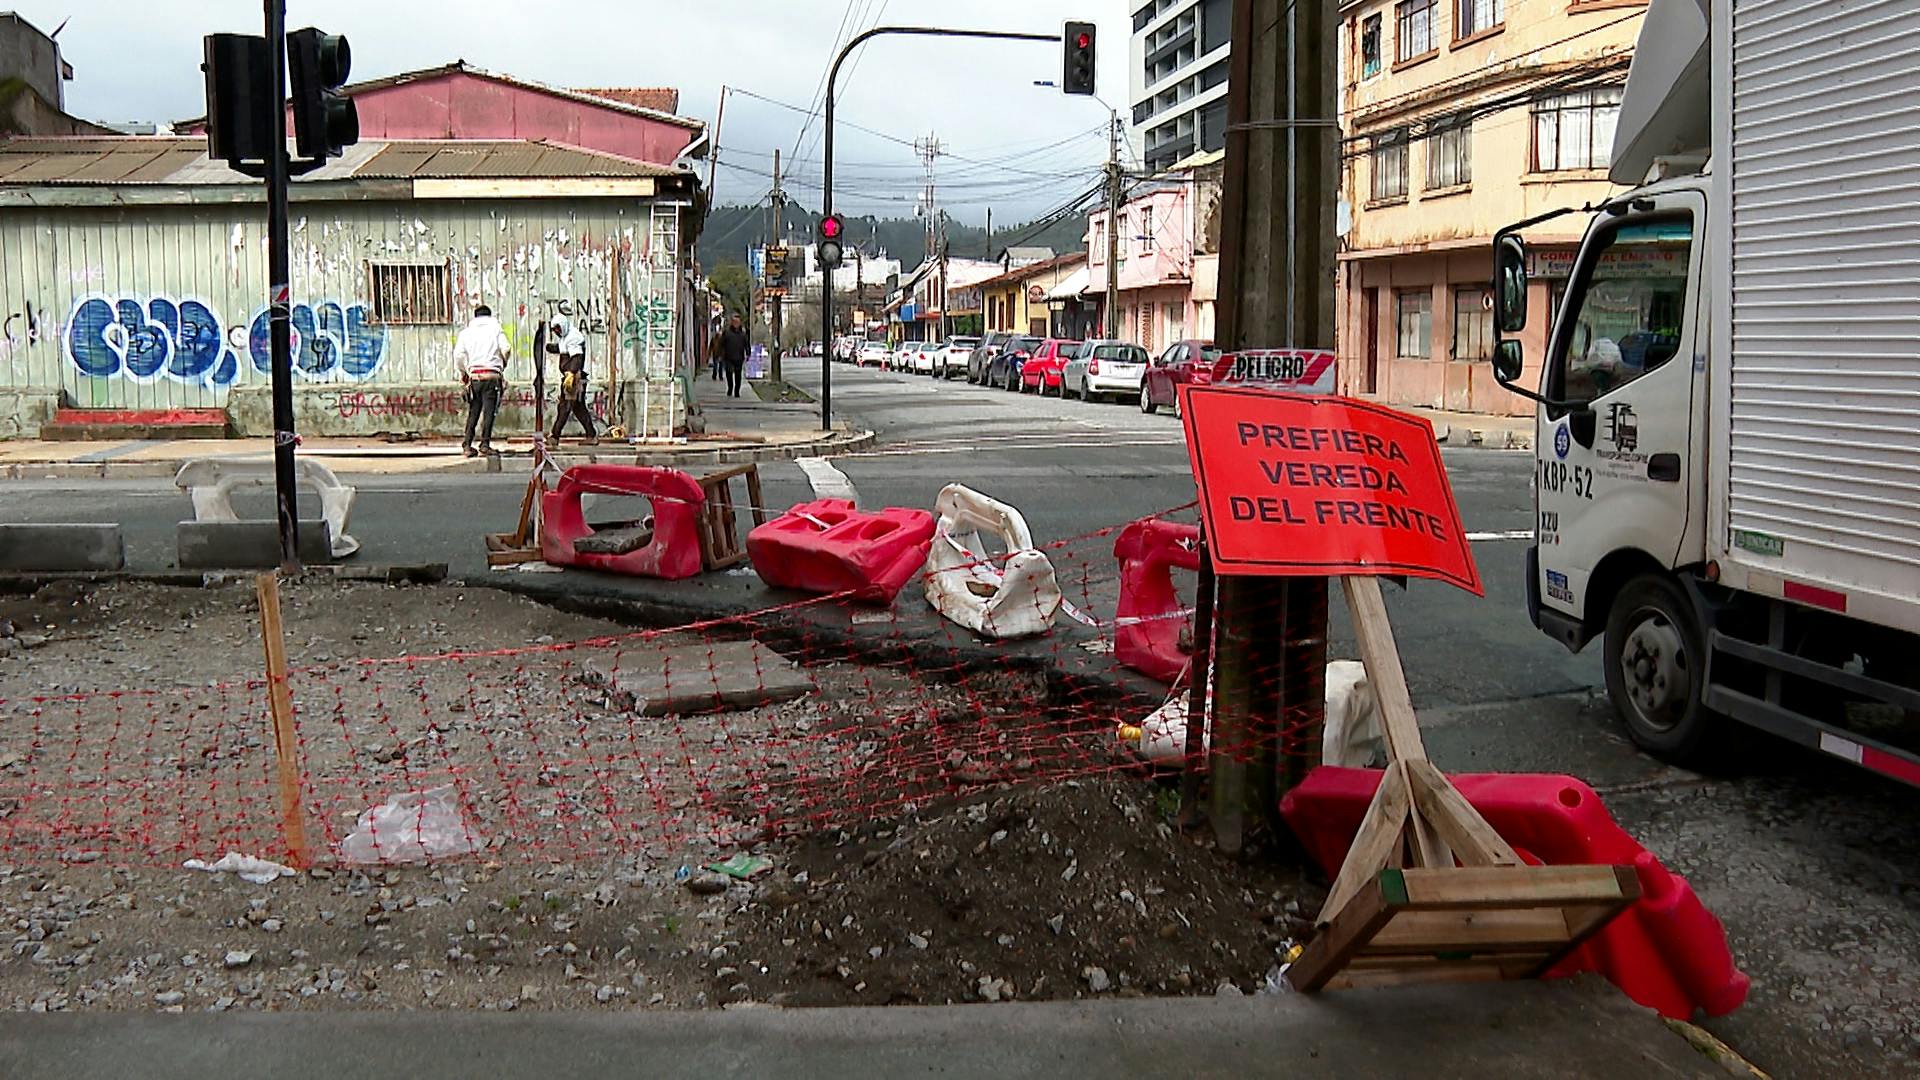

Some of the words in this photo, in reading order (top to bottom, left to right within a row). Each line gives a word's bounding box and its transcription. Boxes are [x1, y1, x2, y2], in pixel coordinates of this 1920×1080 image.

[1236, 356, 1305, 379] PELIGRO
[1238, 422, 1409, 466] PREFIERA
[1259, 460, 1409, 496] VEREDA
[1229, 496, 1306, 524] DEL
[1314, 501, 1448, 541] FRENTE
